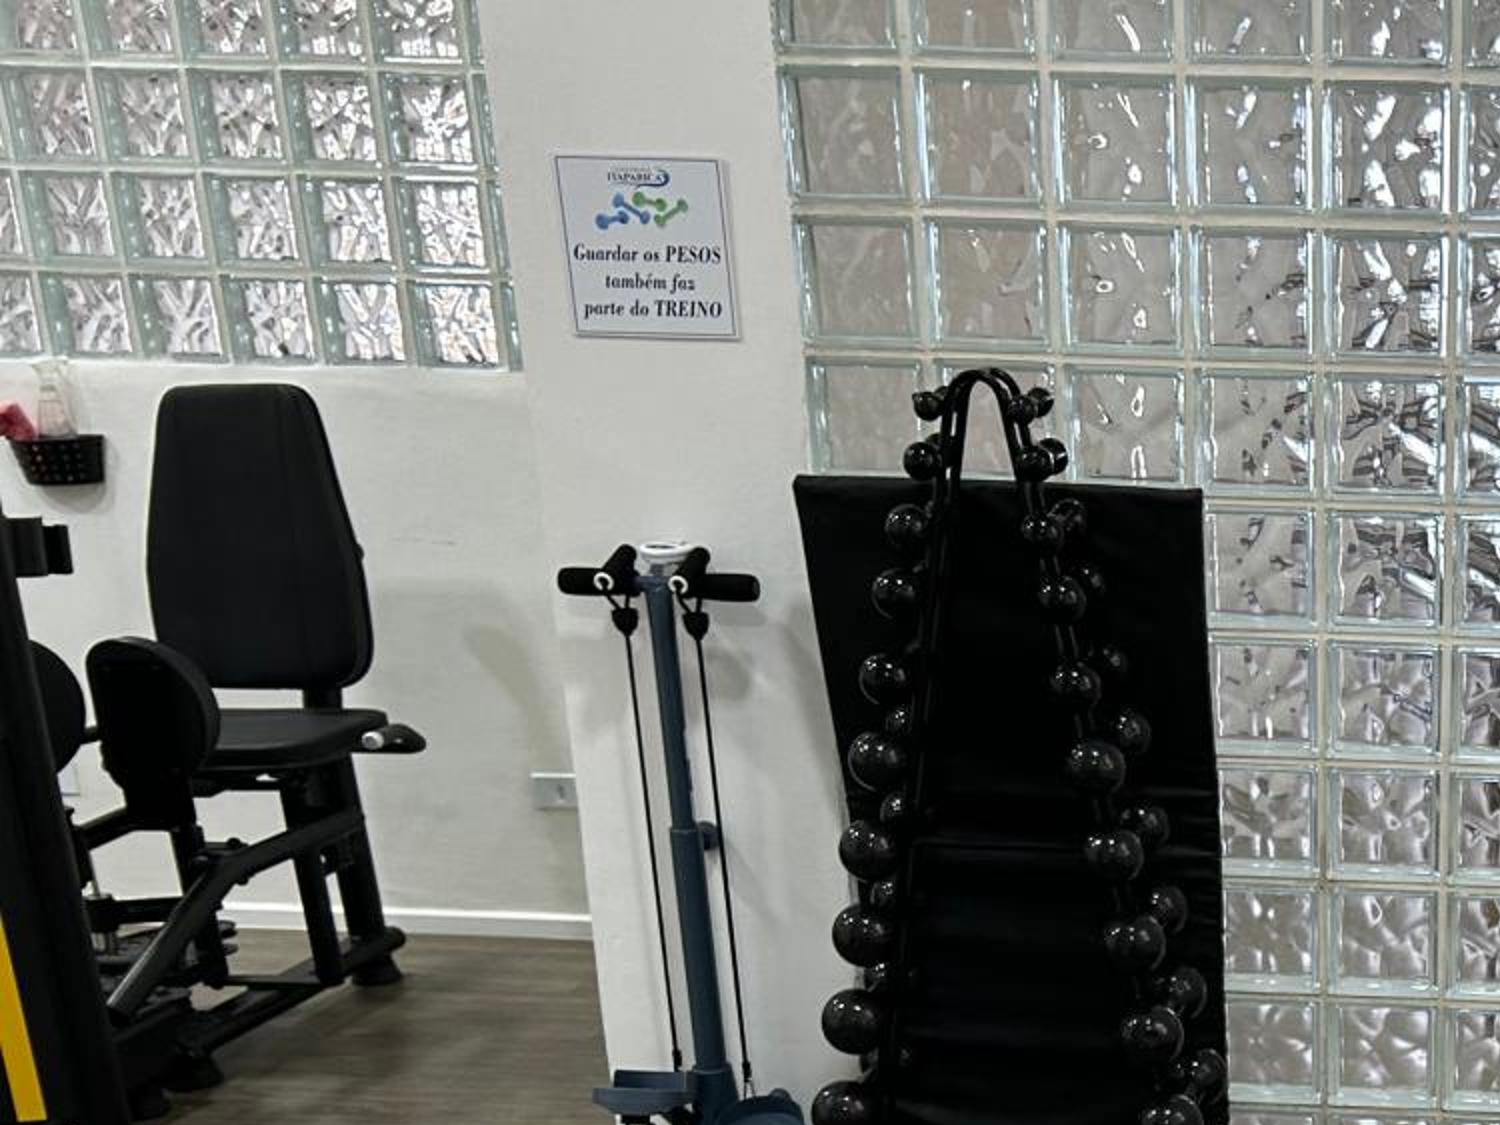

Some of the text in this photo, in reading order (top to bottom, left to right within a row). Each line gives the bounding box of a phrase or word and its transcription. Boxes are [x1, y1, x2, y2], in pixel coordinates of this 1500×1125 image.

[573, 243, 721, 264] Guardar os PESOS
[605, 272, 696, 295] também faz
[583, 299, 722, 320] parte do TREINO
